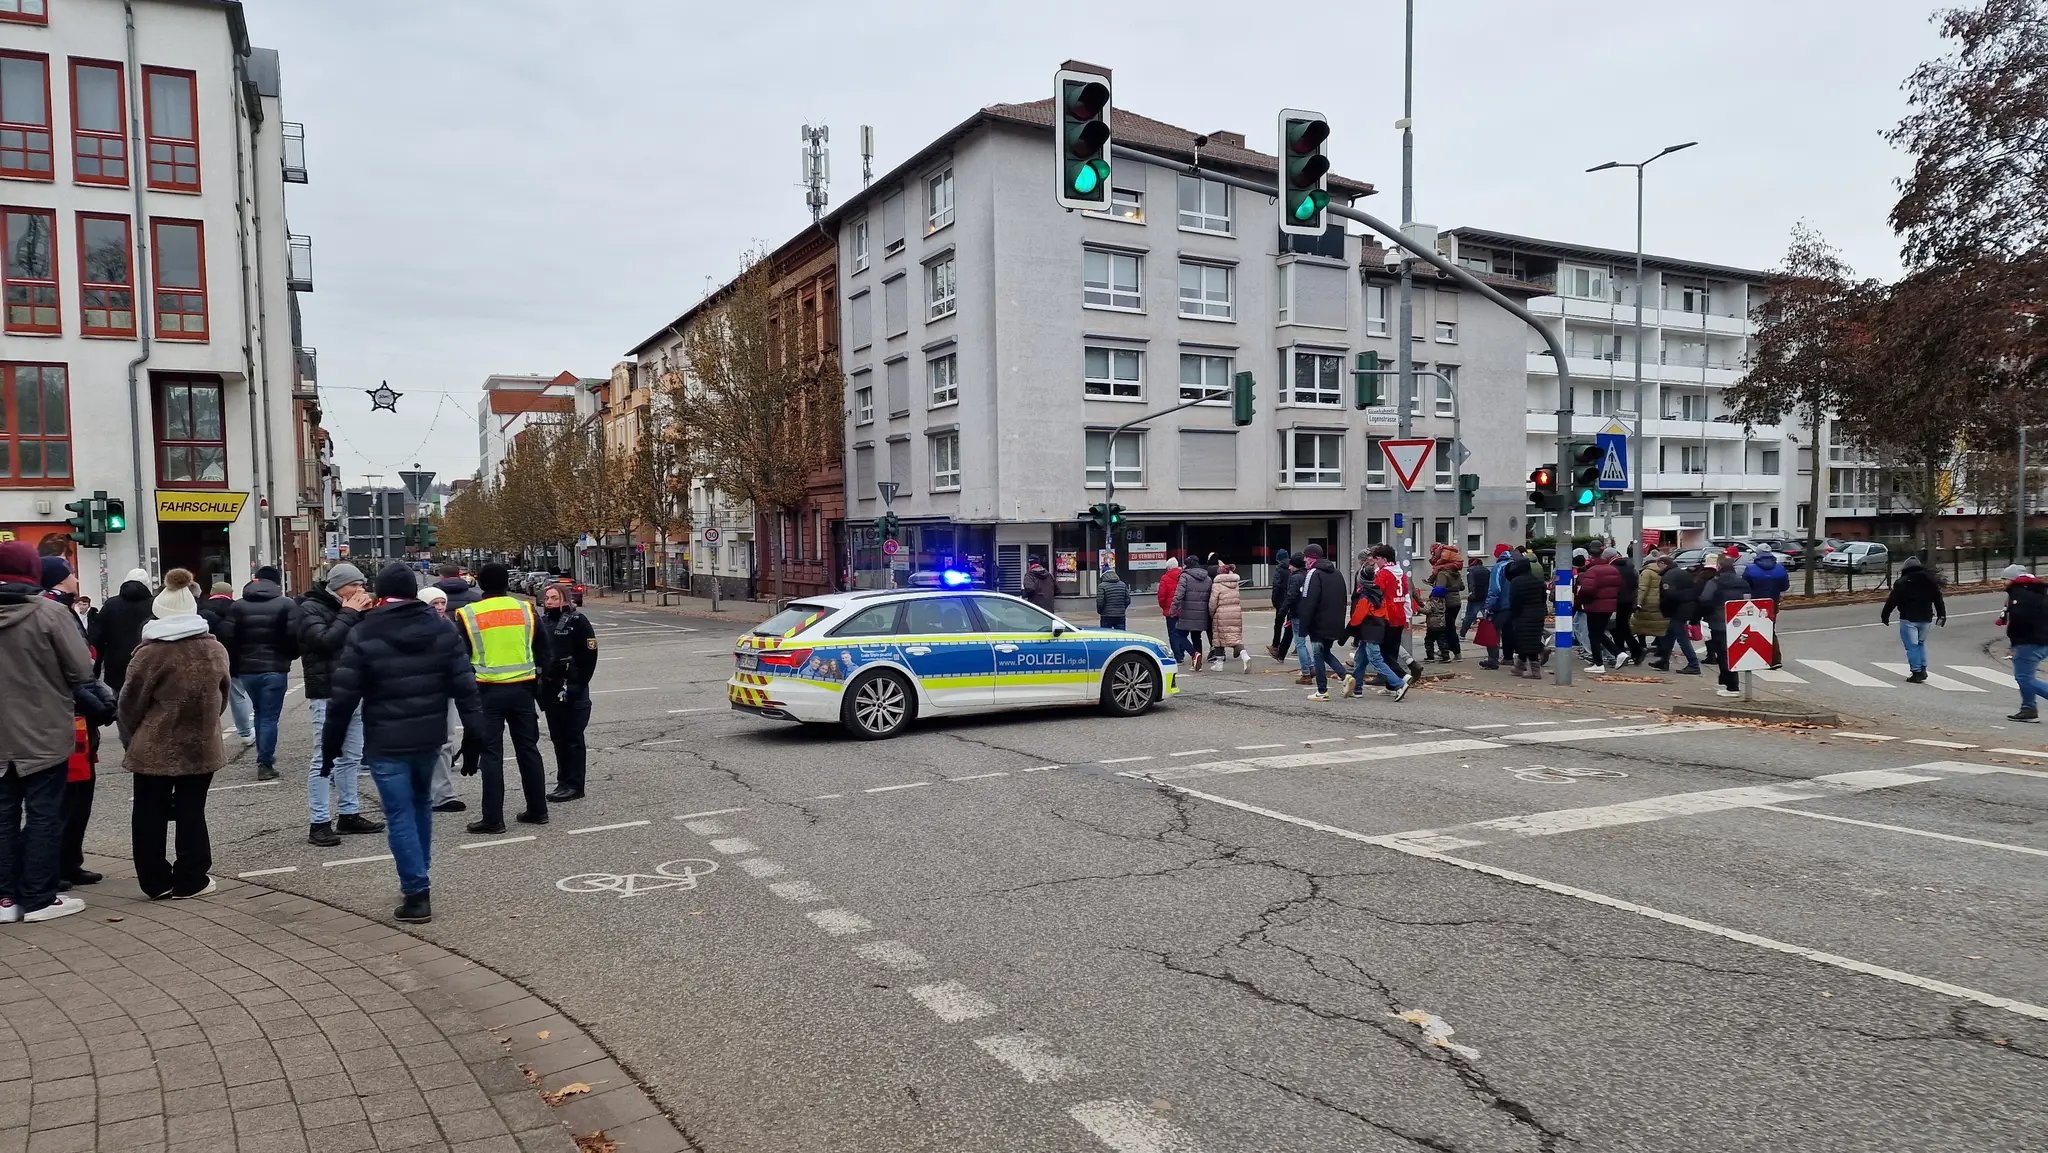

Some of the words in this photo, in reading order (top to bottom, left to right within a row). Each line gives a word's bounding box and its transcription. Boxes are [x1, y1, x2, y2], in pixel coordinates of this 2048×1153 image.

[160, 502, 238, 513] FAHRSCHULE
[708, 531, 717, 539] 30
[1138, 552, 1165, 560] VERMIETEN
[1396, 578, 1403, 597] 3
